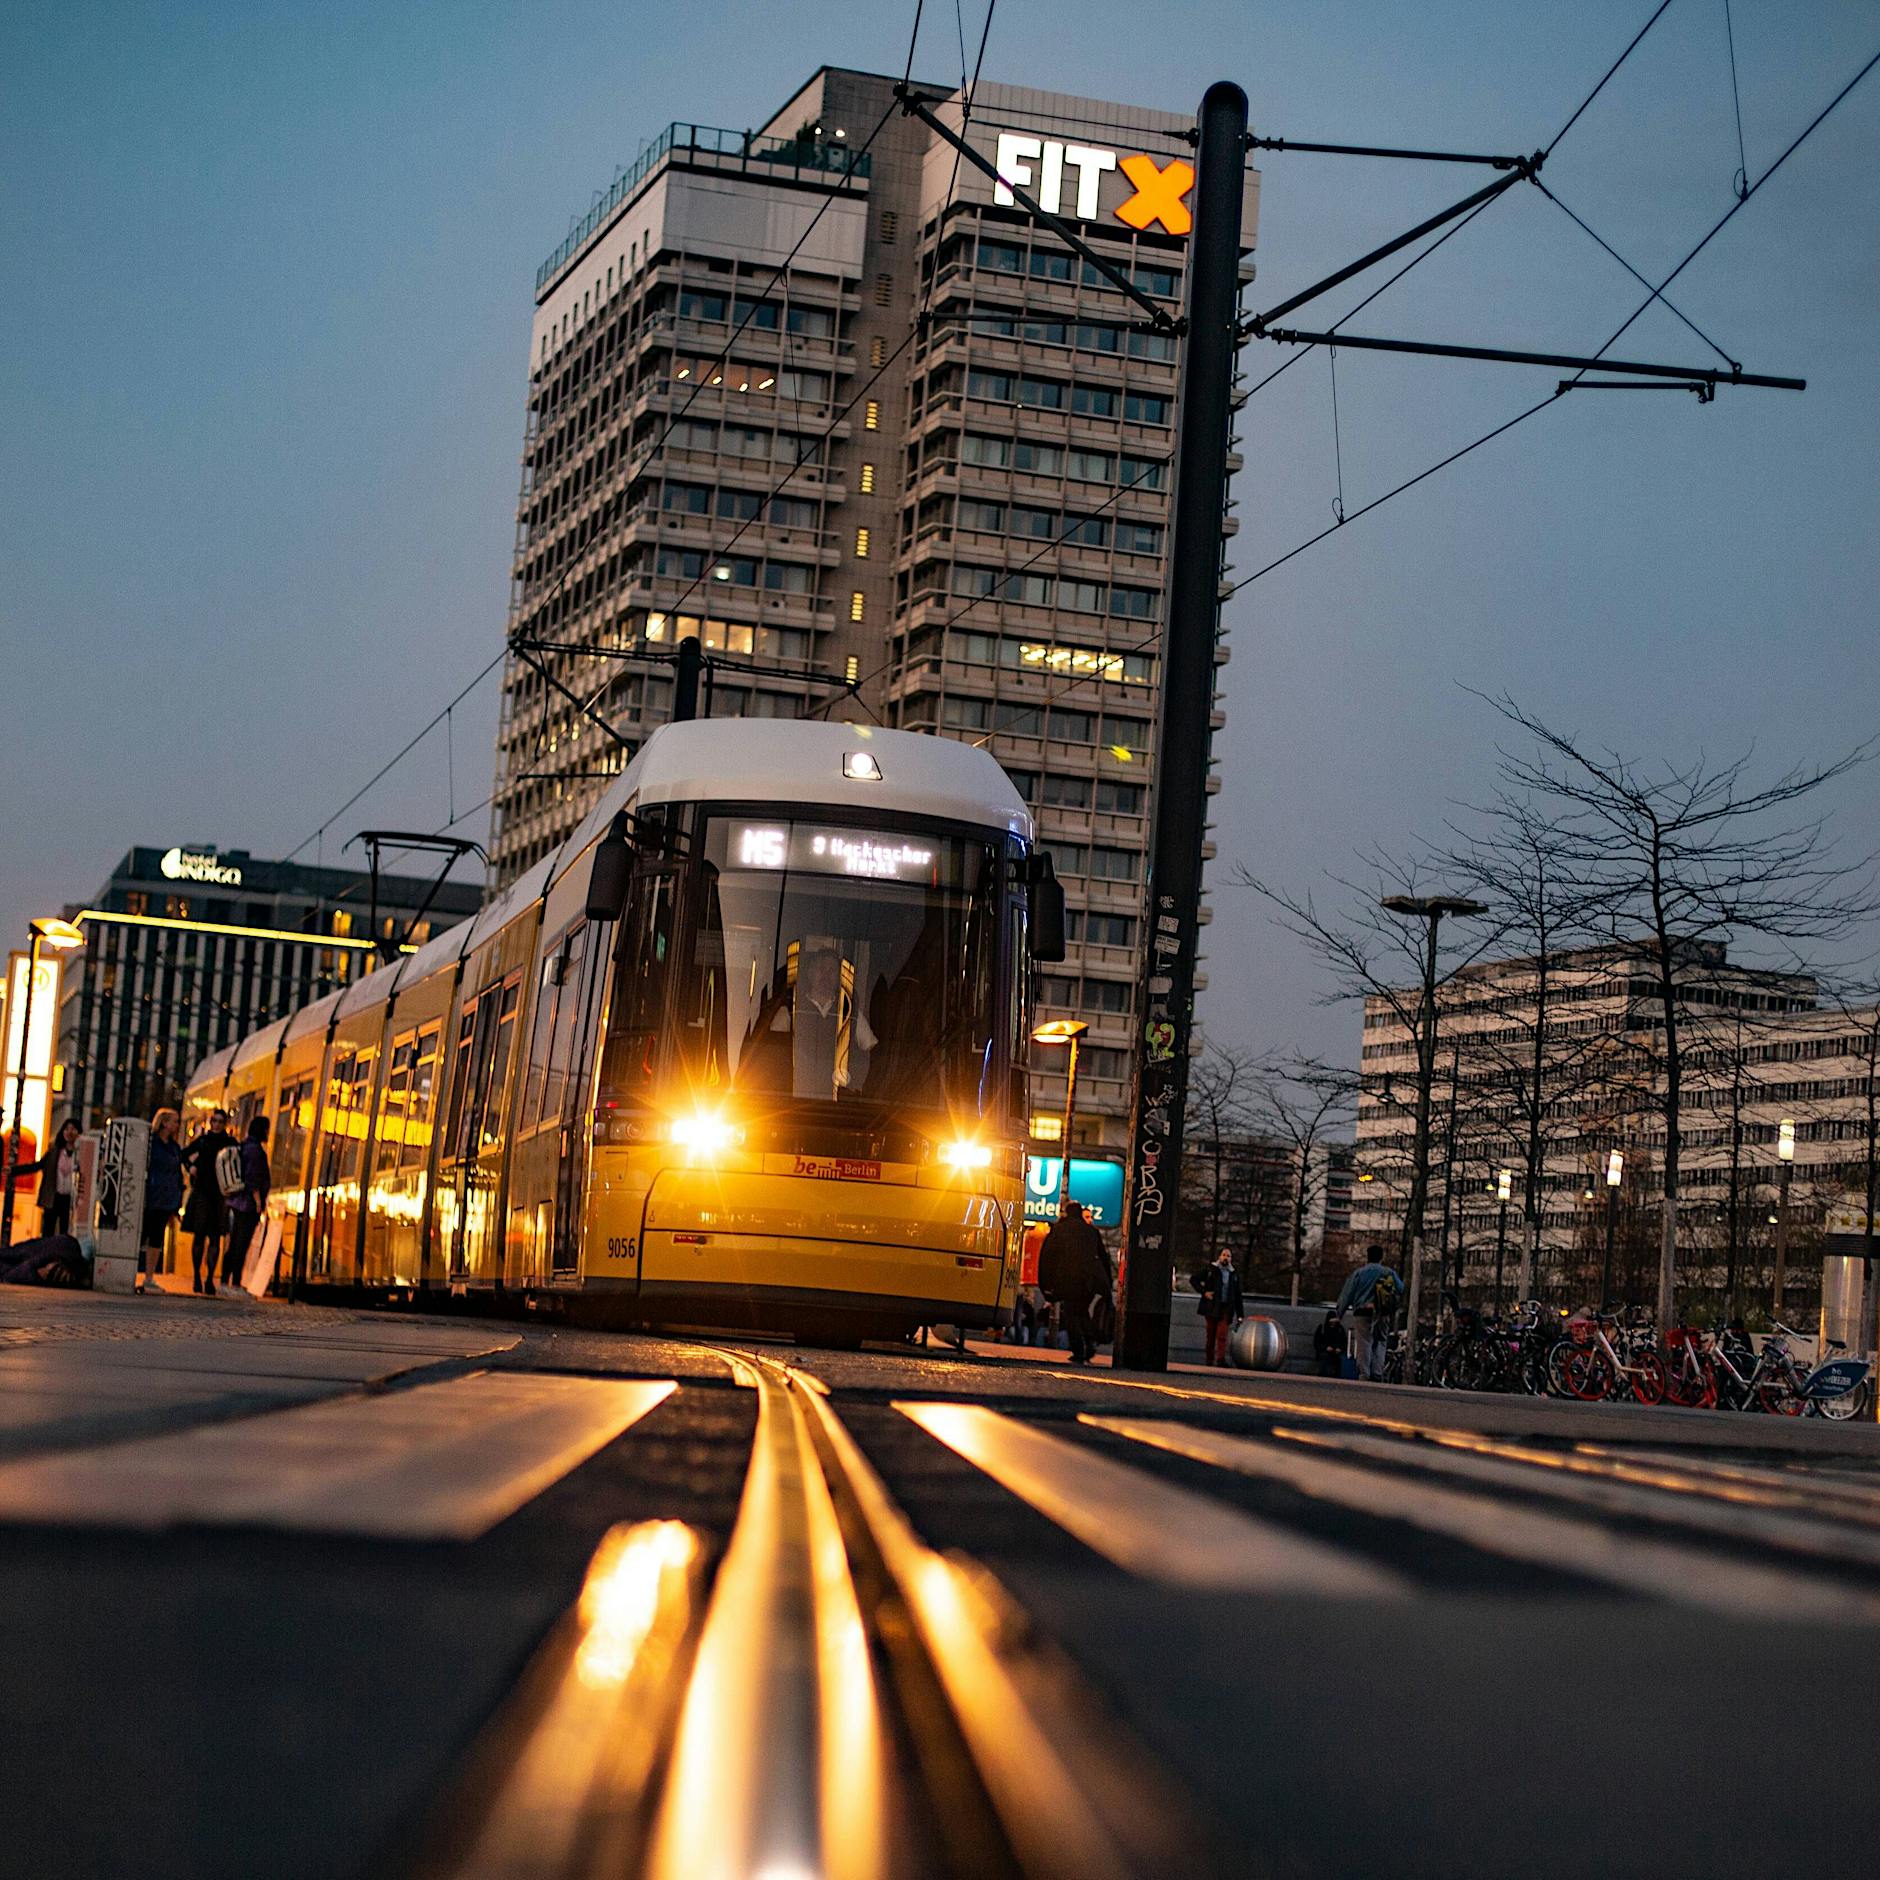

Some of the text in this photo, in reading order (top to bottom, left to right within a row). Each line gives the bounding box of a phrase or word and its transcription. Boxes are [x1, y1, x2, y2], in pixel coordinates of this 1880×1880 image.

[993, 133, 1196, 236] FITX
[741, 829, 784, 866] M5
[844, 1163, 877, 1177] Berlin
[1028, 1156, 1060, 1196] U
[608, 1238, 635, 1258] 9056
